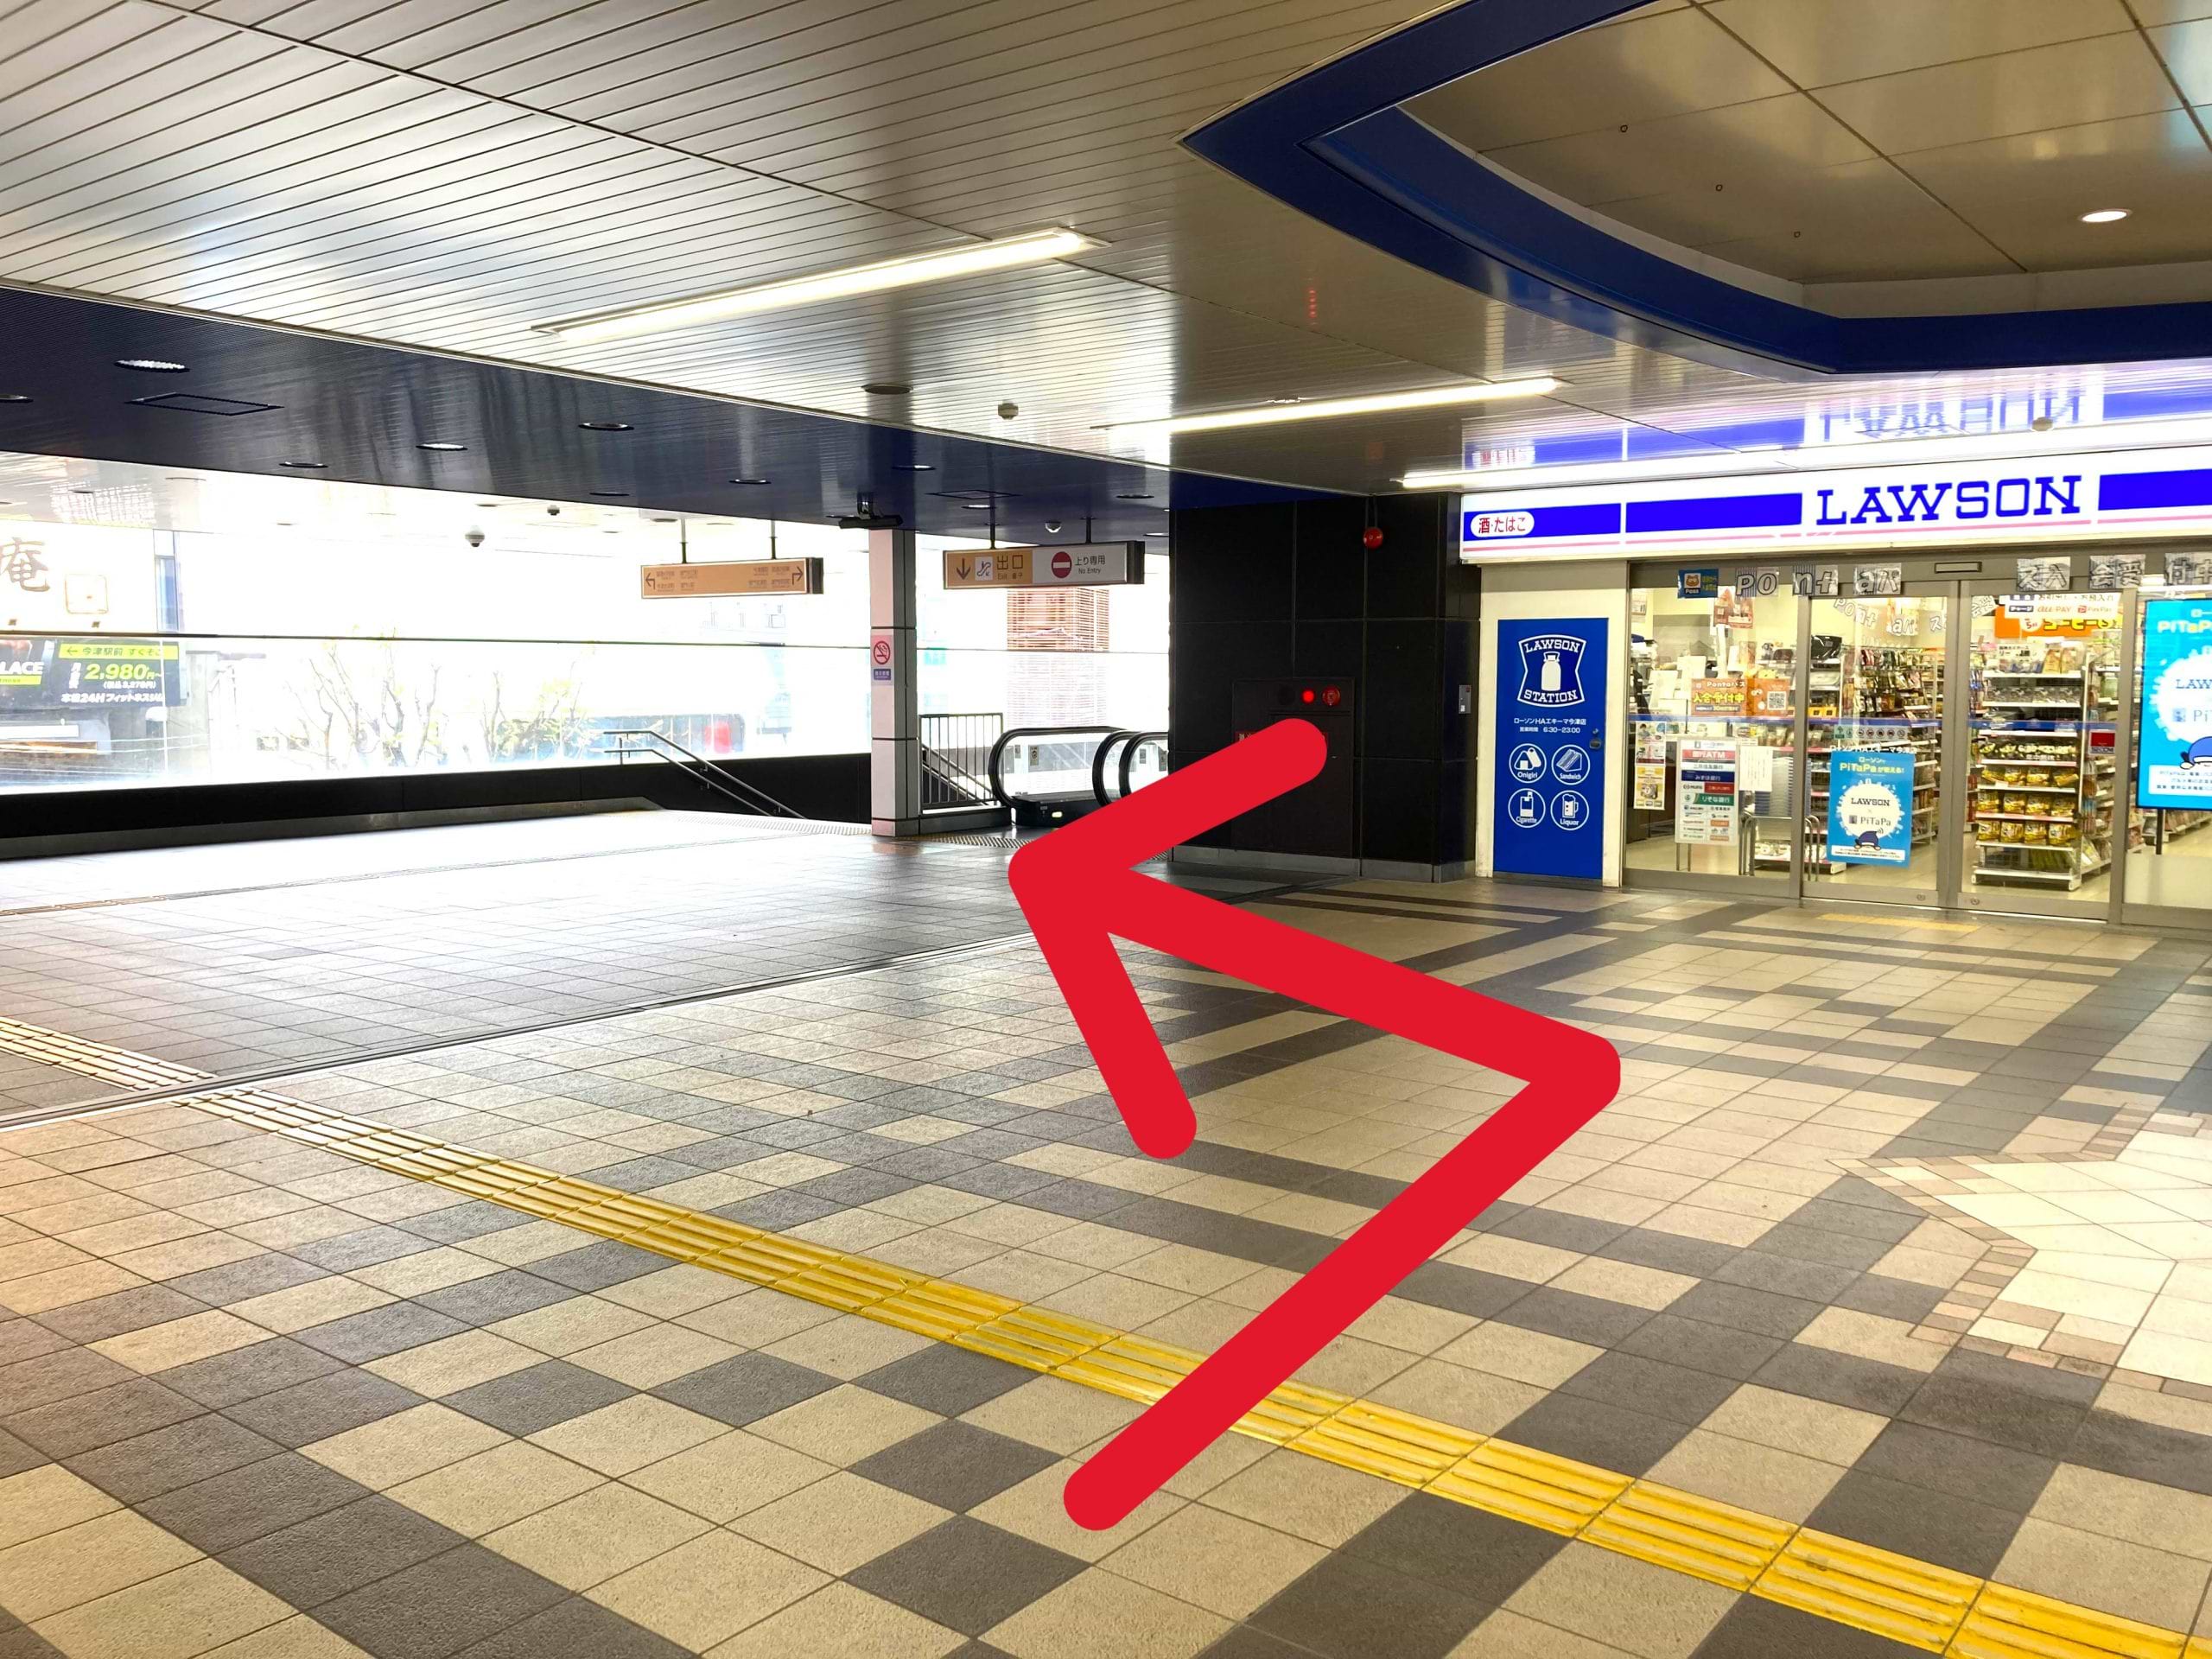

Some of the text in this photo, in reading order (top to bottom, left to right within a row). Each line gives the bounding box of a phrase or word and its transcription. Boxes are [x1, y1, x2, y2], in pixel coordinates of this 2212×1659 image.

[1816, 475, 2082, 525] LAWSON
[996, 552, 1024, 571] 出口
[1074, 555, 1106, 567] 上り専用
[1087, 567, 1102, 575] Entry
[1524, 639, 1580, 653] LAWSON
[1523, 690, 1579, 703] STATION
[1851, 798, 1891, 807] LAWSON
[1859, 816, 1891, 827] PiTaPa
